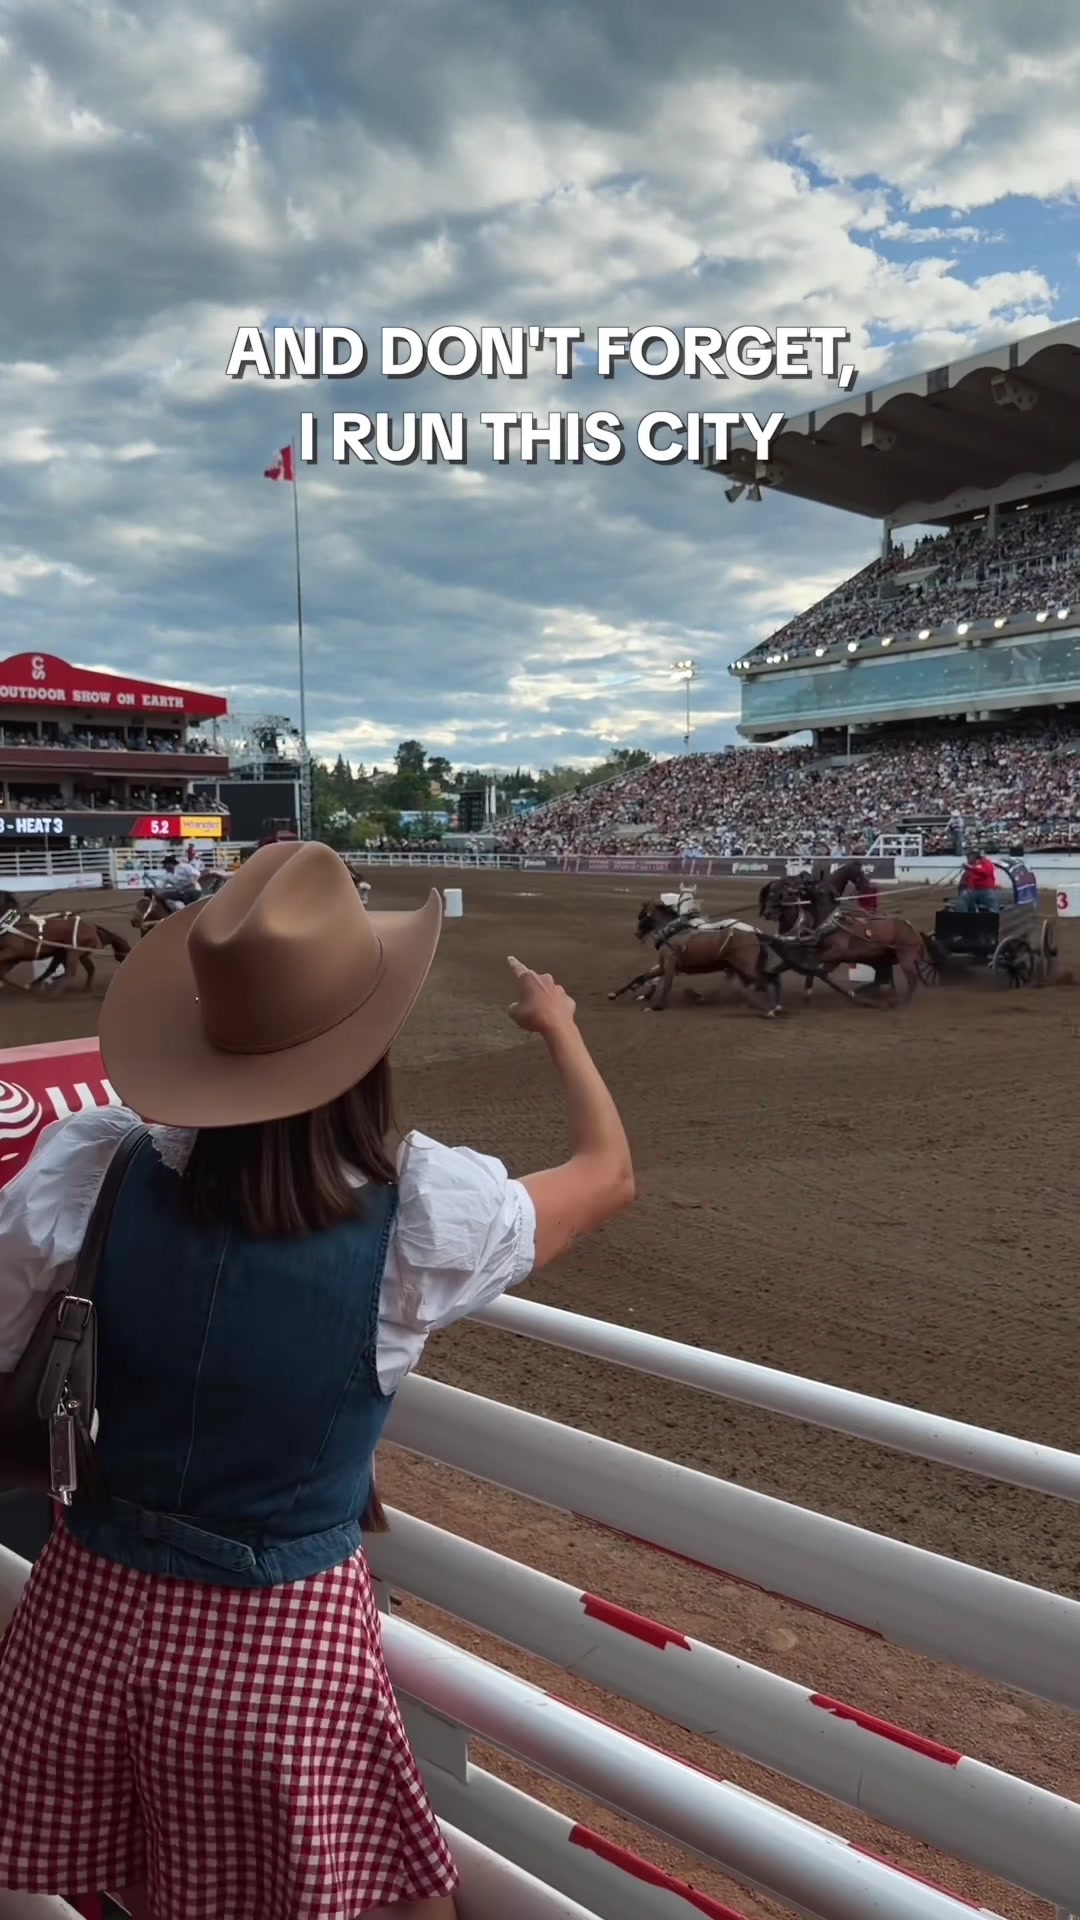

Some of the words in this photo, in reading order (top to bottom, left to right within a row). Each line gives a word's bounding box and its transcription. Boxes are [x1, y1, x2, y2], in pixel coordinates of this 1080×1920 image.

[0, 685, 66, 701] OUTDOOR
[72, 689, 111, 704] SHOW
[116, 692, 135, 706] ON
[141, 694, 184, 708] EARTH
[15, 817, 52, 834] HEAT
[52, 817, 64, 834] 3
[150, 820, 170, 834] 5.2
[1056, 891, 1069, 910] 3
